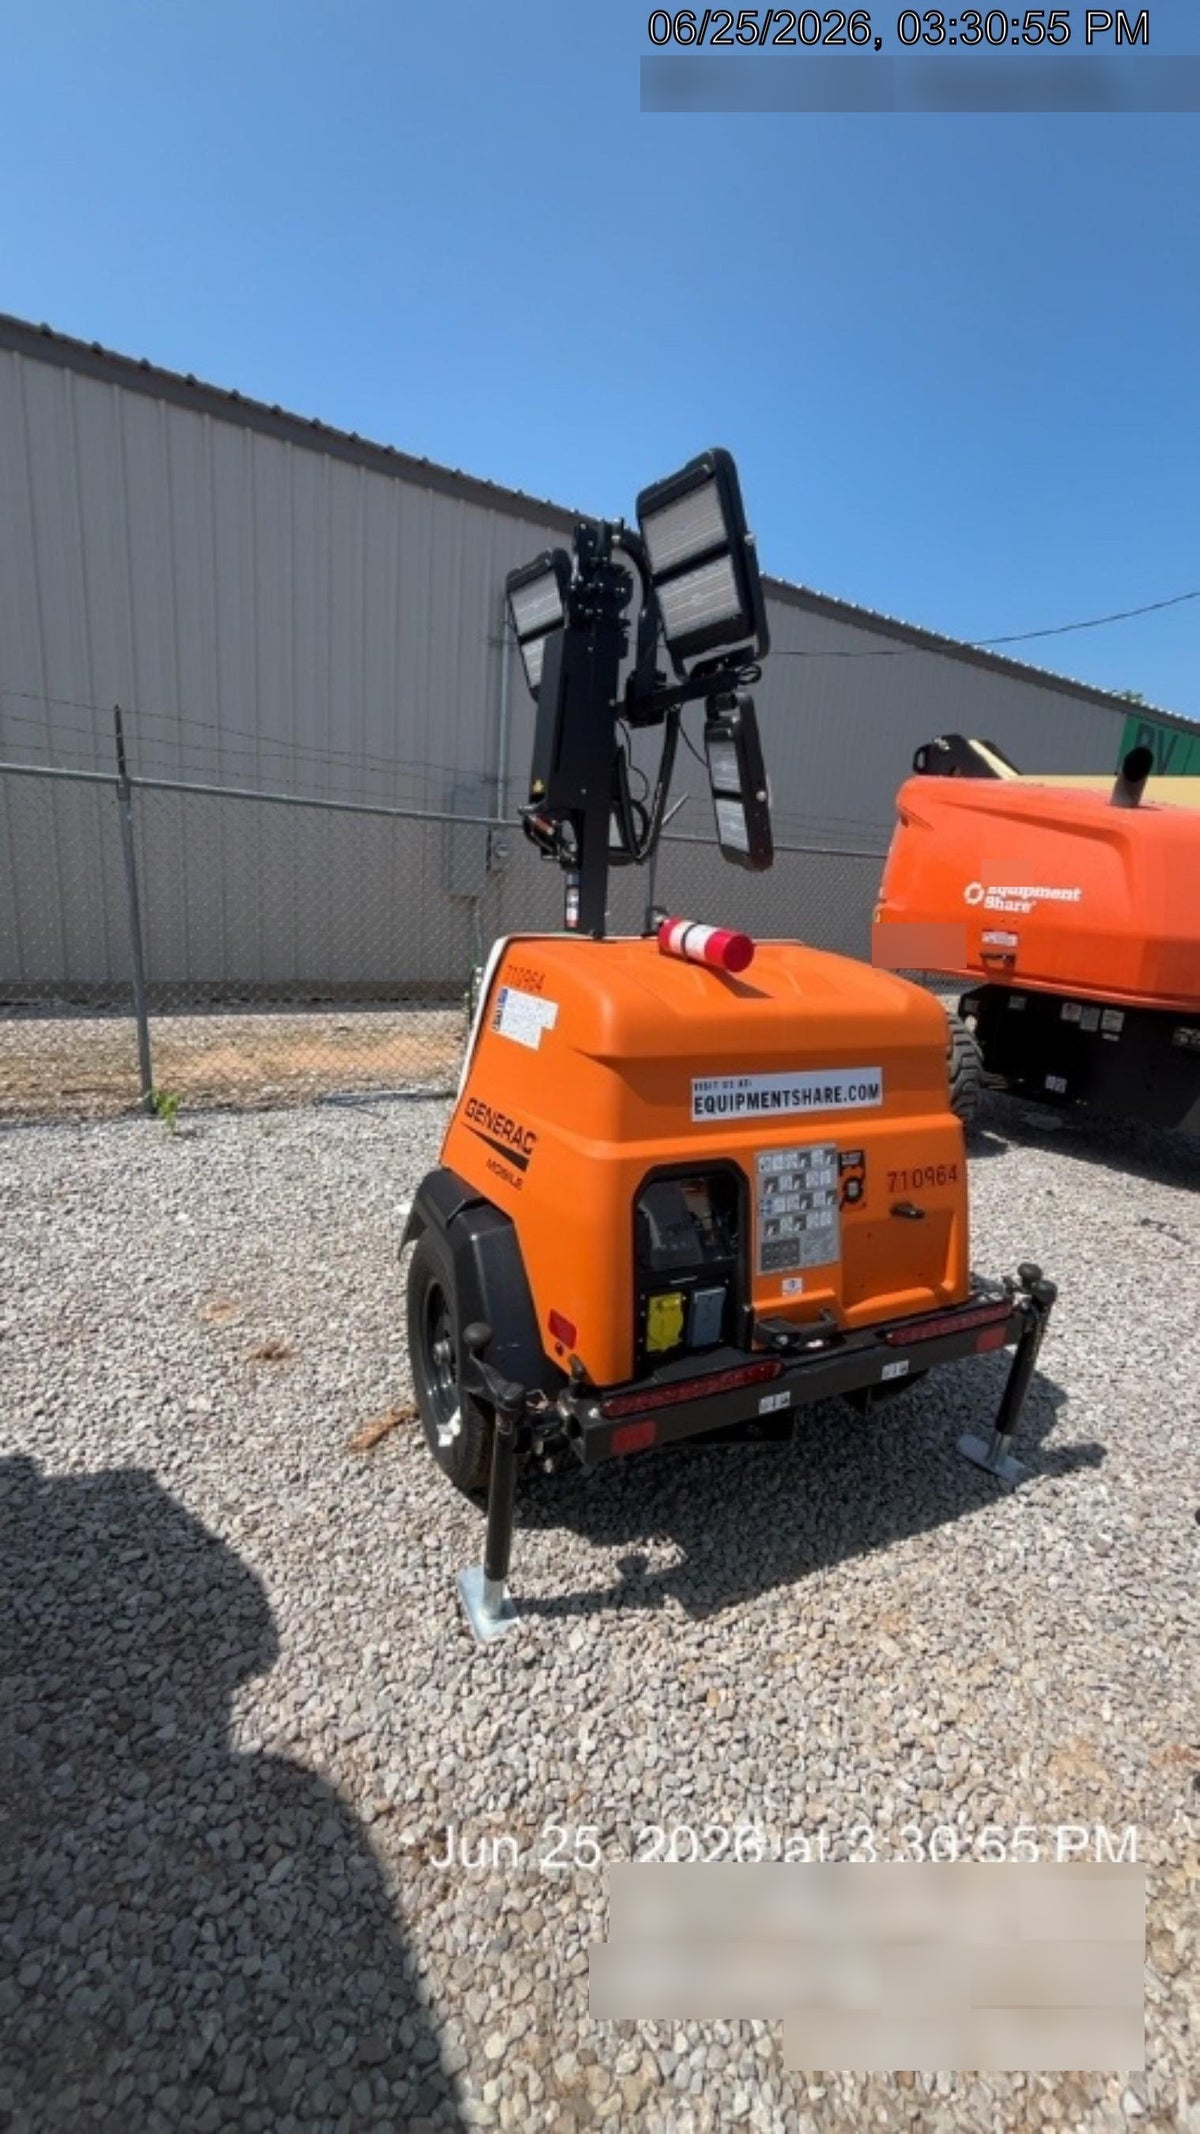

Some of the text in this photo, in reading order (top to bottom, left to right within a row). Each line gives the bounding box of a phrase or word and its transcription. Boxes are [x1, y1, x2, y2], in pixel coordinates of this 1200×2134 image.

[694, 1083, 880, 1116] EQUIPMENTSHARE.COM
[464, 1097, 537, 1156] GENERAC
[887, 1164, 958, 1194] 710964
